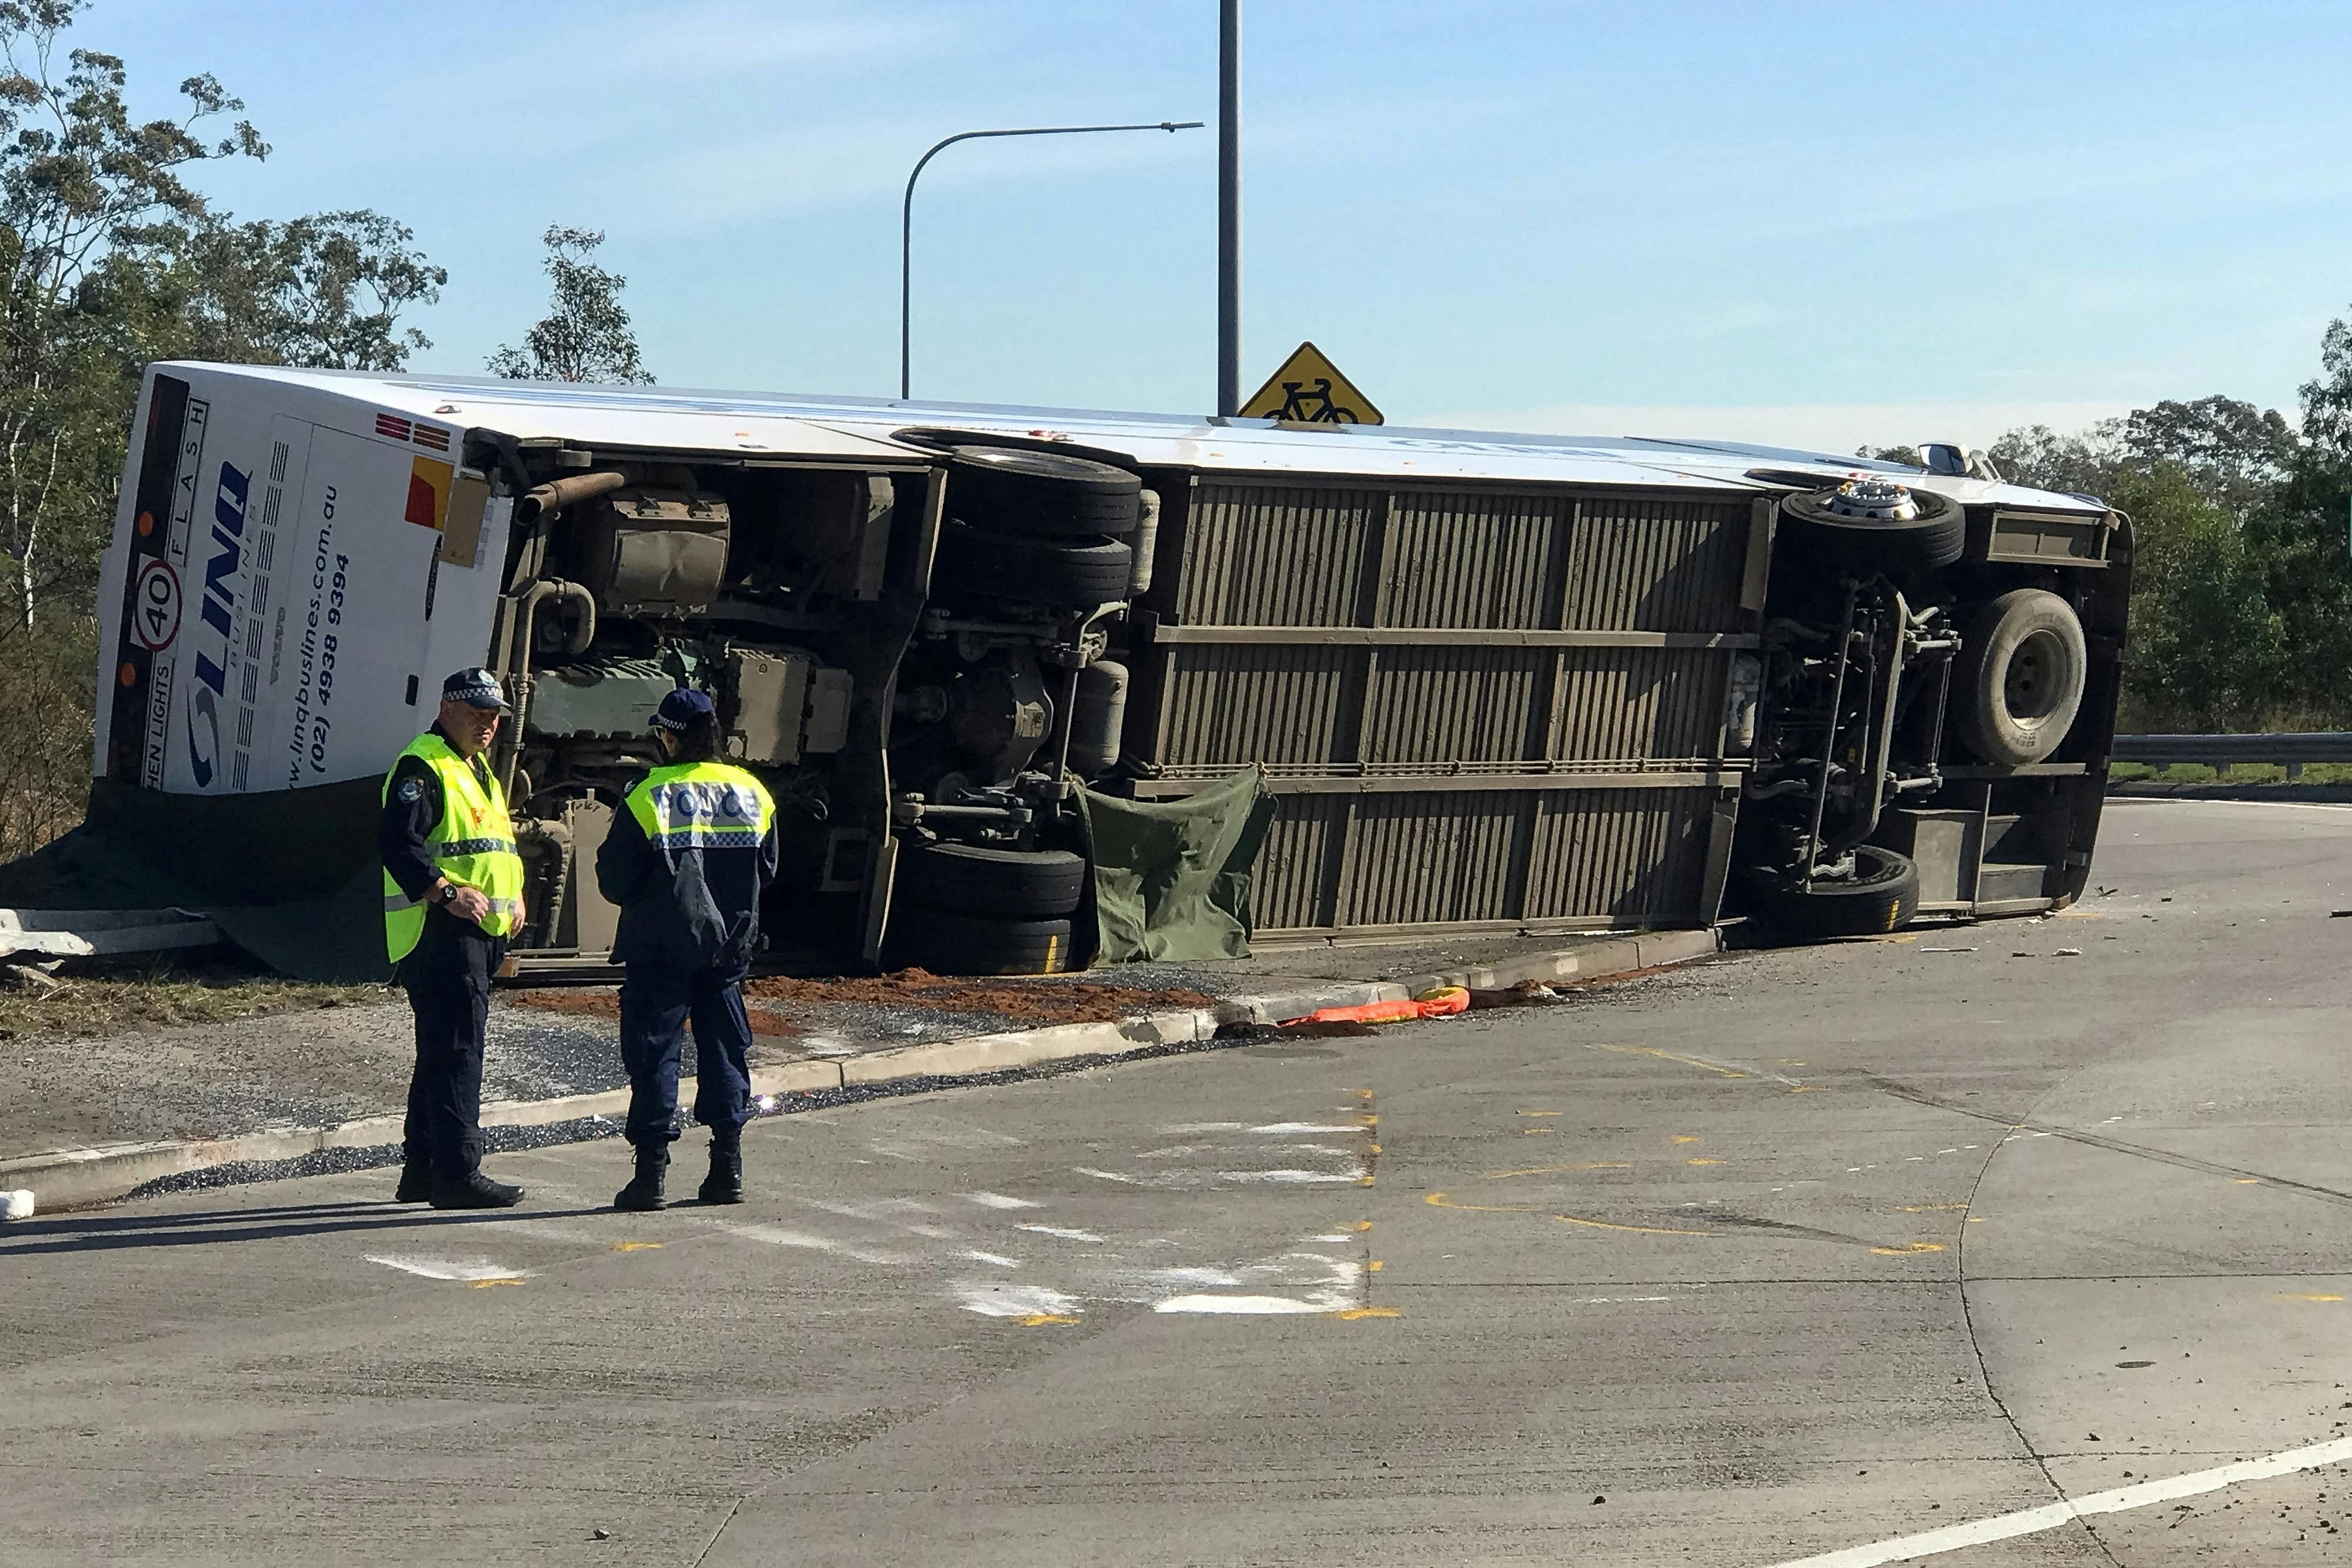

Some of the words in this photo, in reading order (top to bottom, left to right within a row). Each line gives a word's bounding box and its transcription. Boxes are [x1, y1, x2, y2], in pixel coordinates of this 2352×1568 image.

[171, 406, 203, 555] FLASH
[146, 574, 171, 638] 40
[194, 461, 253, 697] LINQ
[231, 503, 256, 668] BUSLINES
[328, 553, 349, 626] 9394
[151, 665, 169, 738] LIGHTS
[318, 633, 338, 706] 4938
[310, 716, 331, 773] (02)
